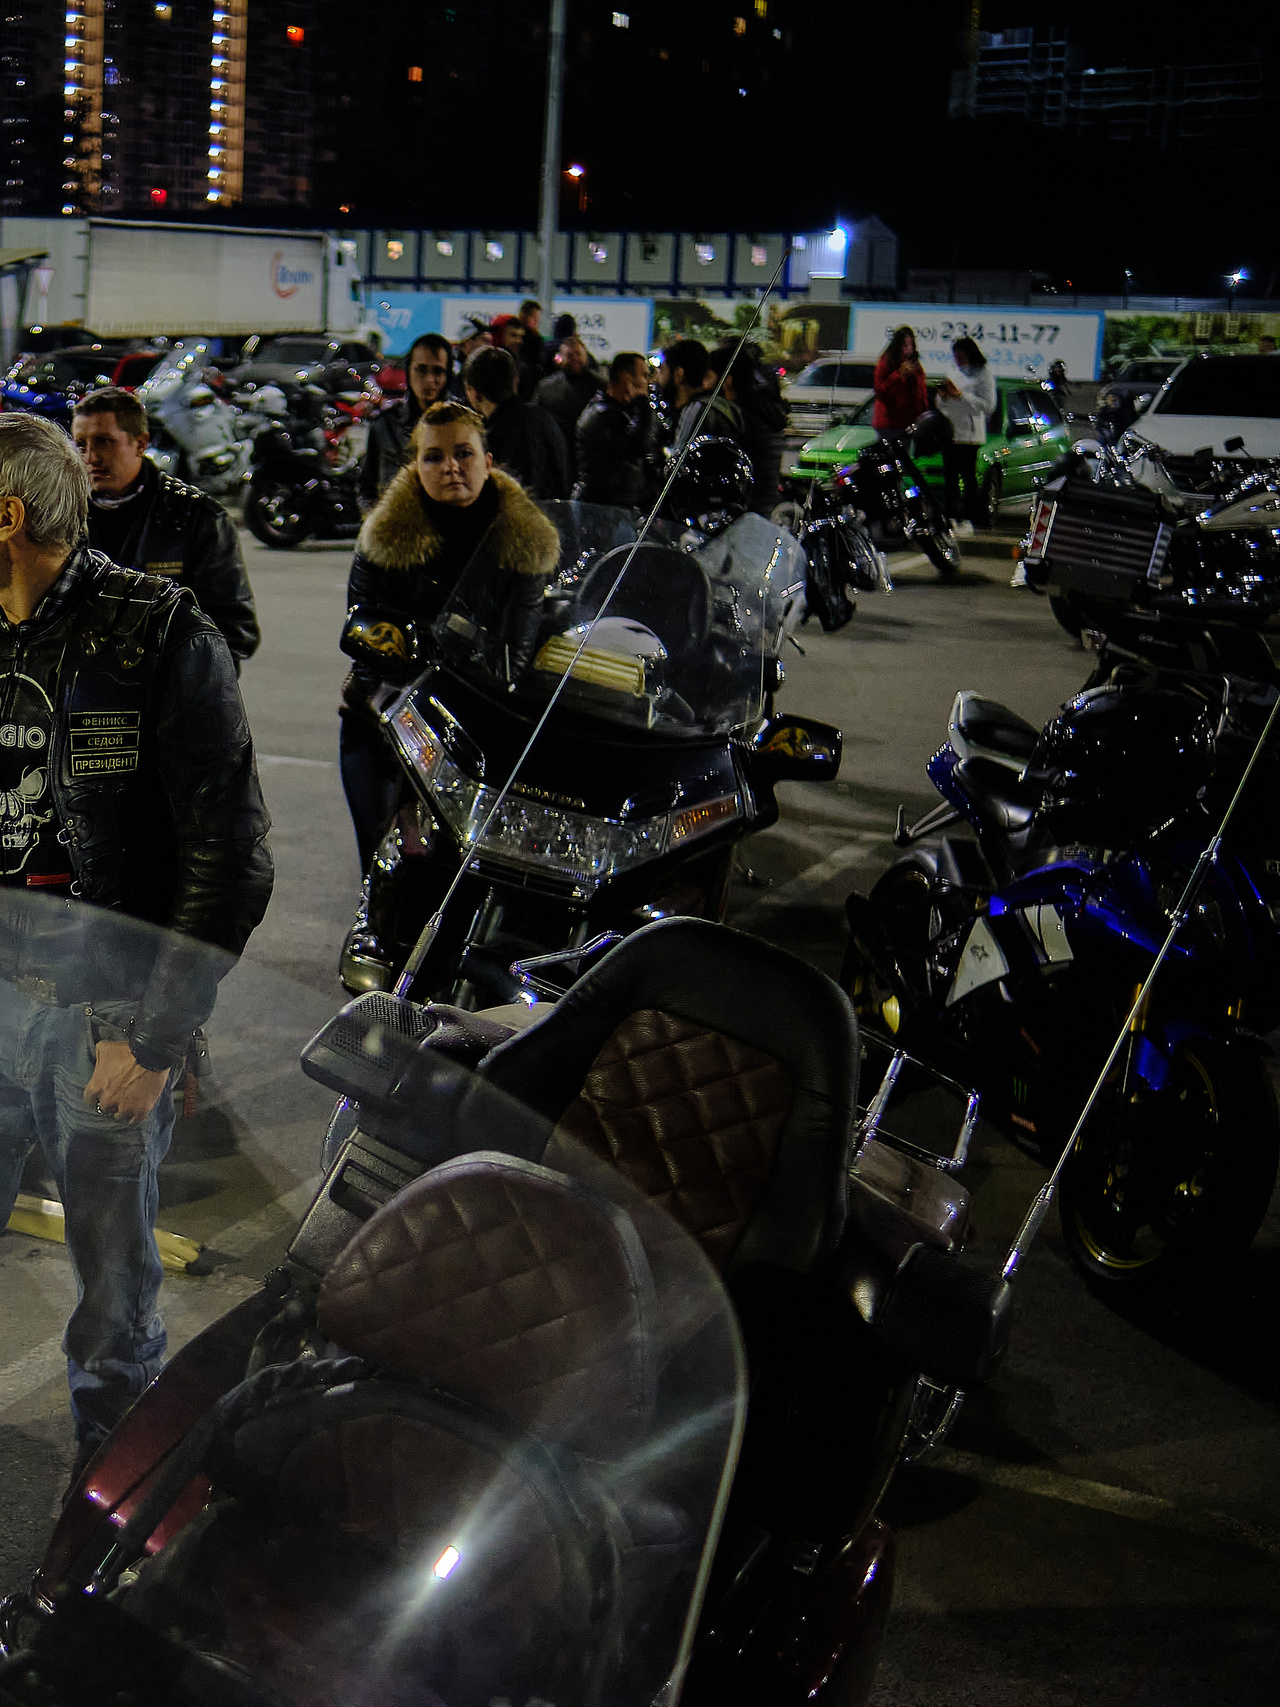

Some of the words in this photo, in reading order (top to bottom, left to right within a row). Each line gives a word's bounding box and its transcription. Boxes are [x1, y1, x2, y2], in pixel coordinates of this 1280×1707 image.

[82, 716, 128, 727] ФЕНИКС
[87, 734, 123, 747] СЕДОЙ
[75, 756, 135, 771] ПРЕЗИДЕНТ
